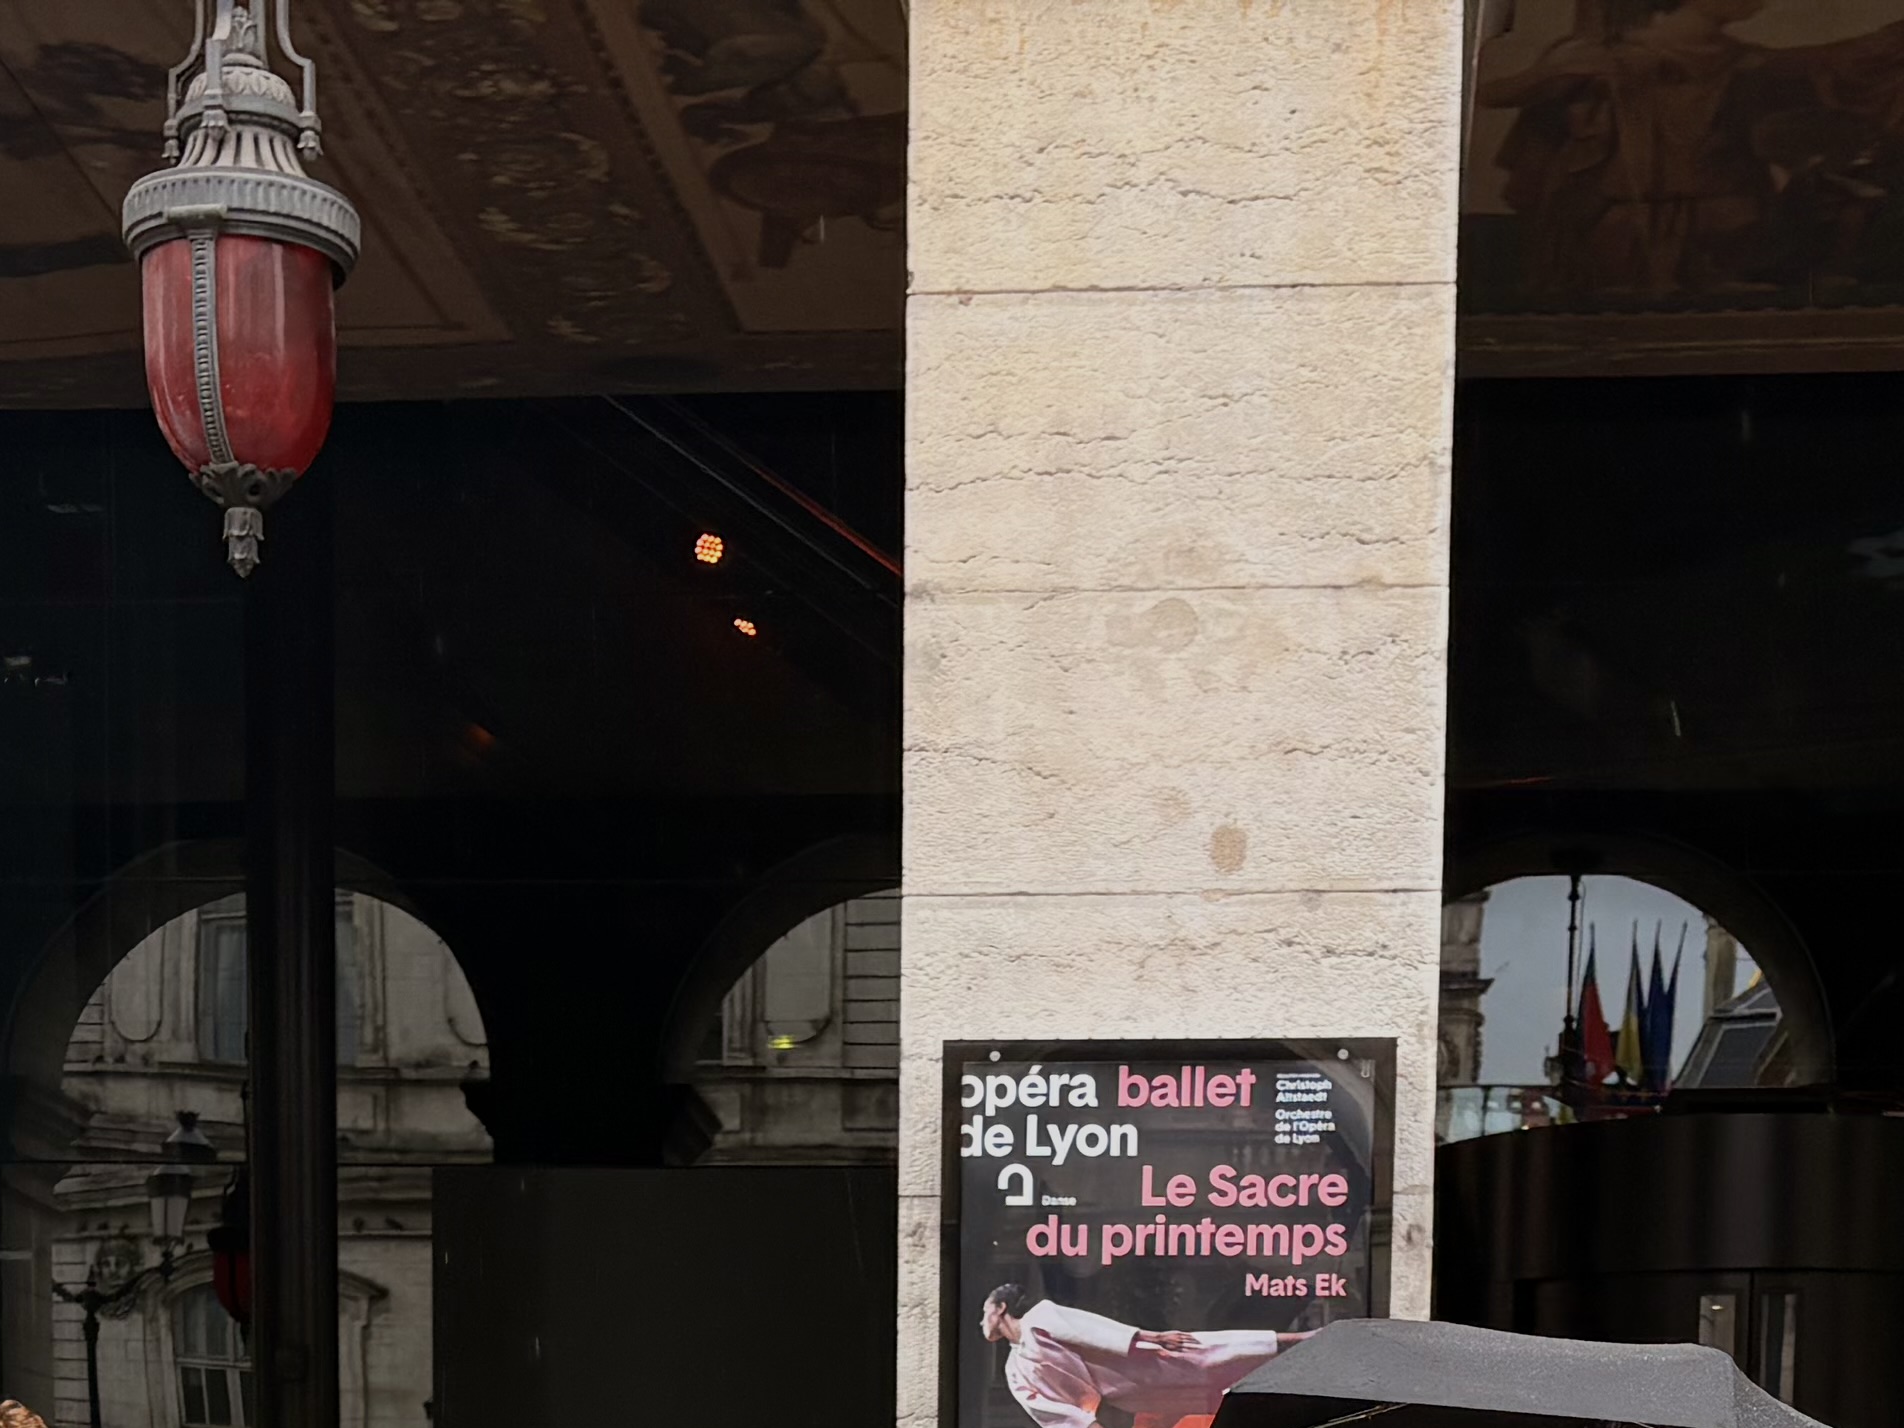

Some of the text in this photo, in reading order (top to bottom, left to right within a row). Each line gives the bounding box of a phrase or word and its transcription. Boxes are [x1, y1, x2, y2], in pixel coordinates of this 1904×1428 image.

[961, 1065, 1256, 1117] opéra ballet
[1275, 1109, 1332, 1120] Orchestre
[961, 1115, 1139, 1166] de Lyon
[1141, 1165, 1349, 1208] Le Sacre
[1026, 1214, 1349, 1266] du printemps
[1245, 1273, 1348, 1298] Mats Ek
